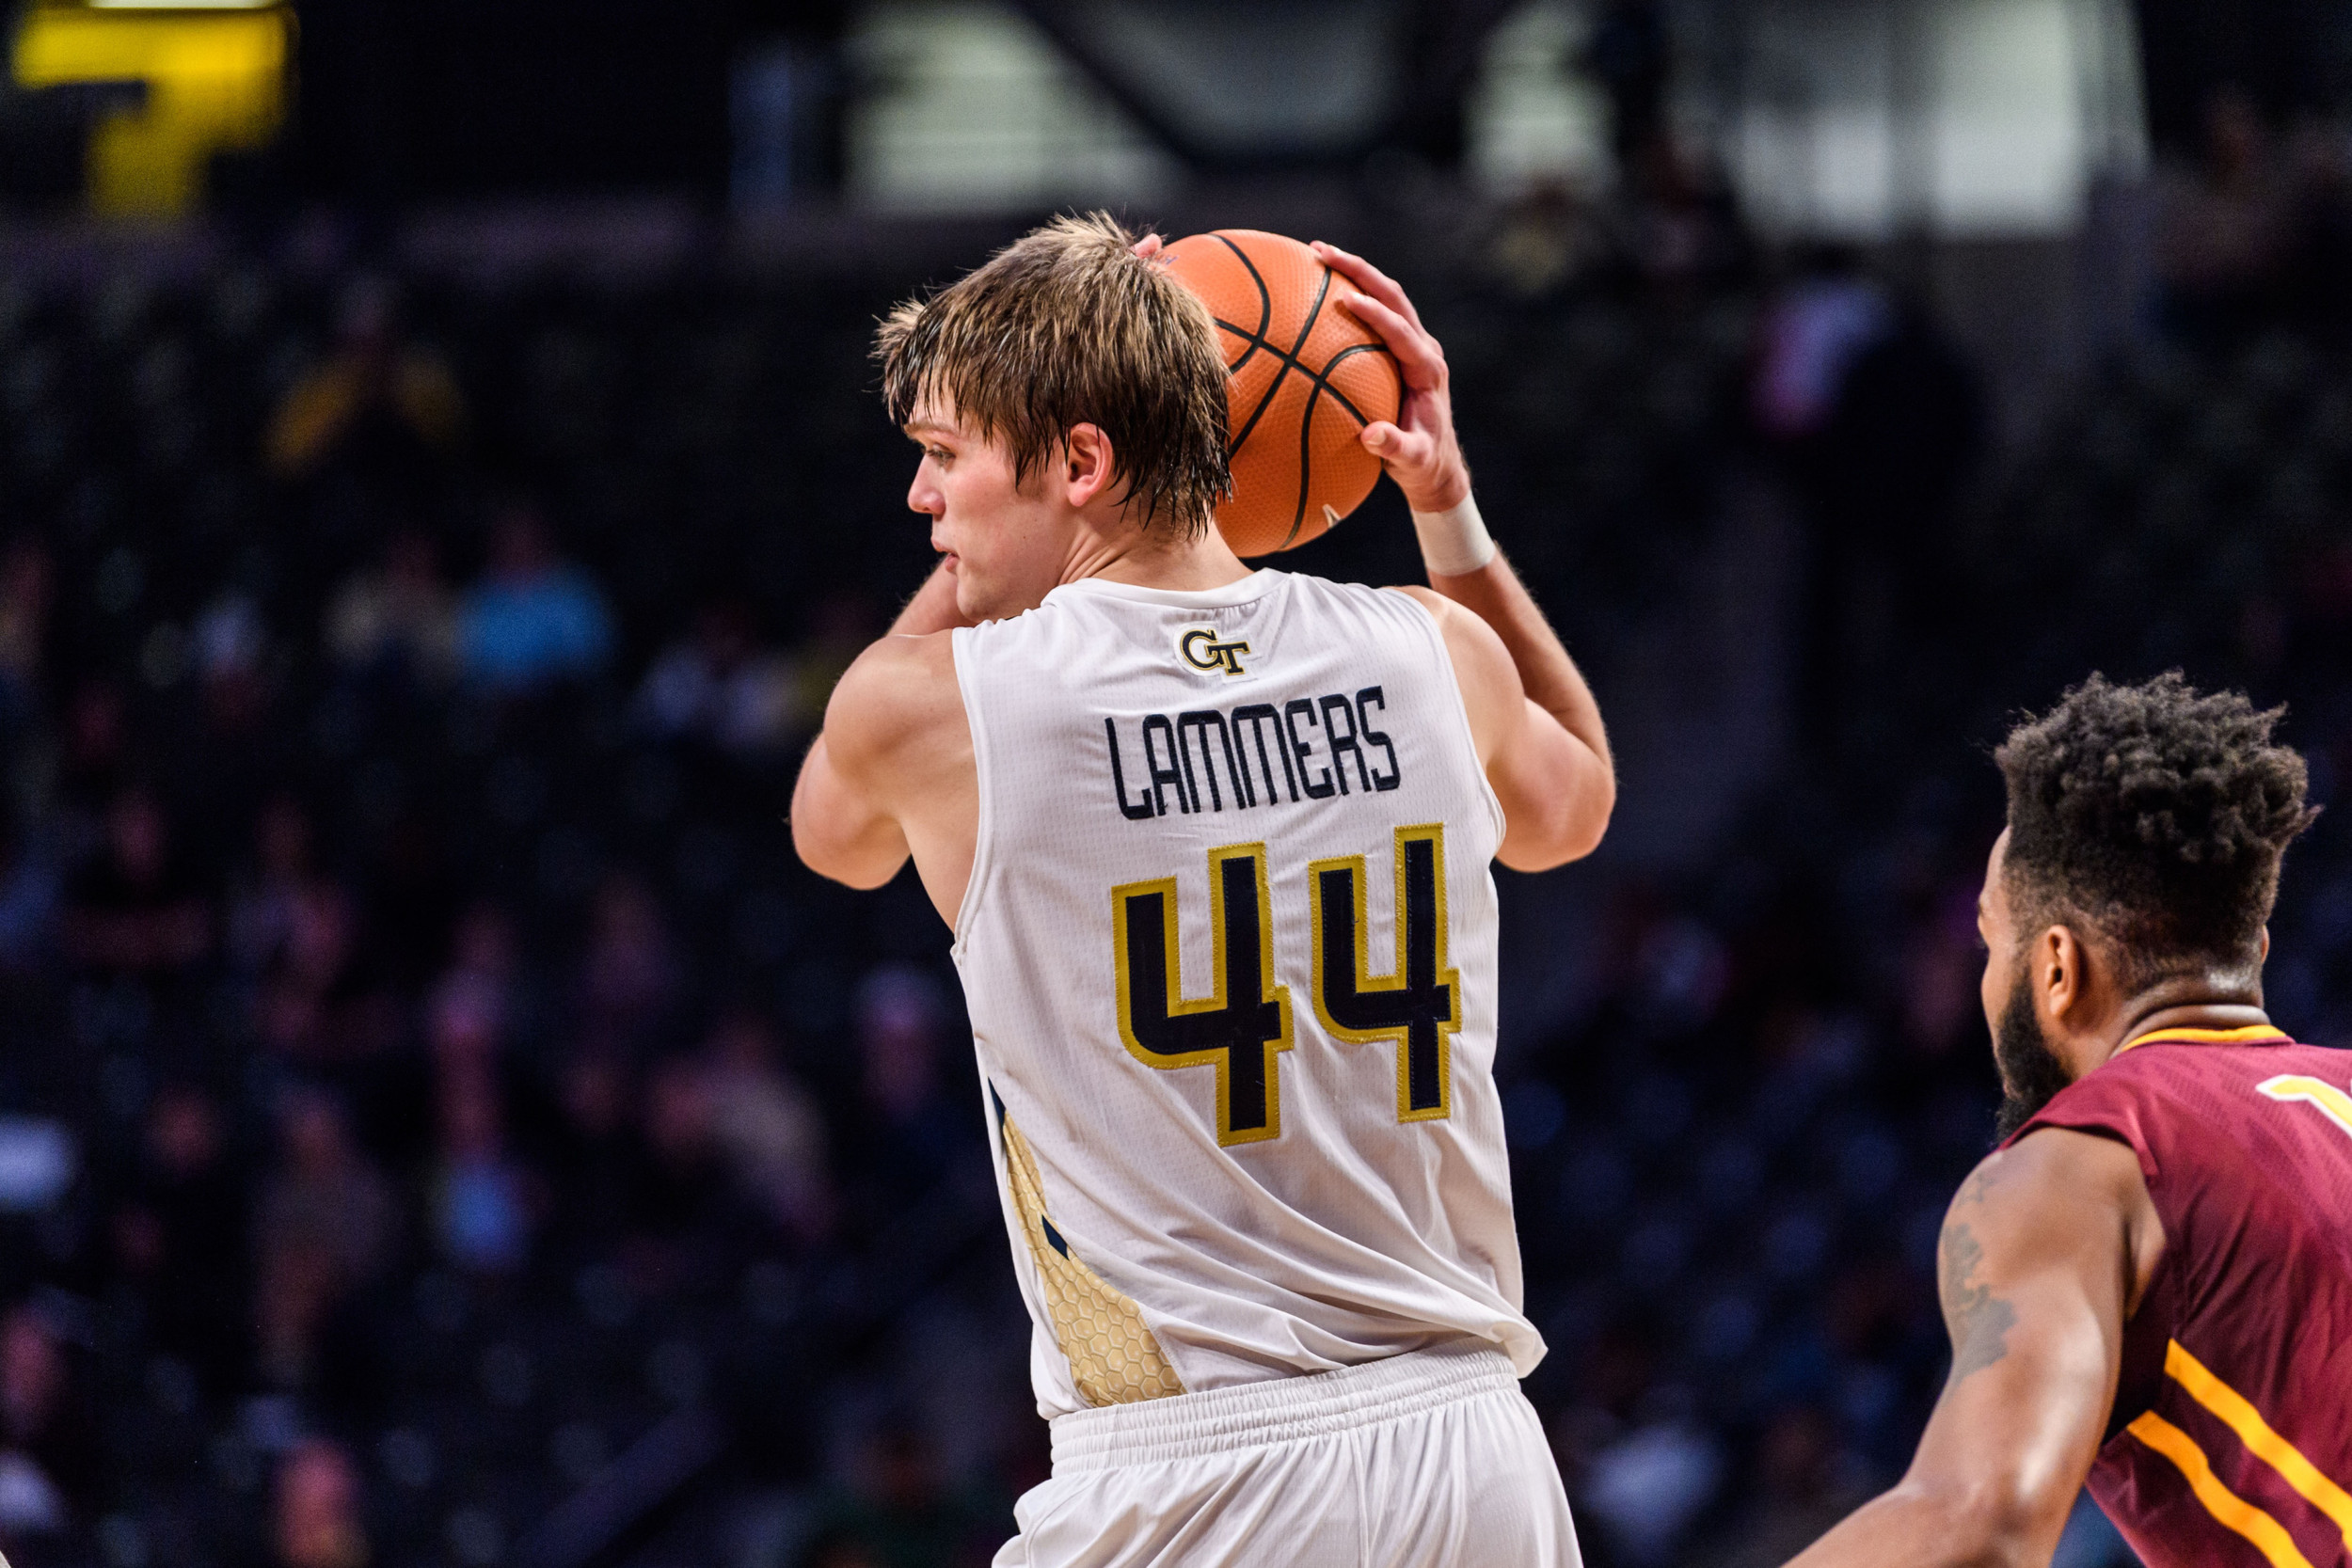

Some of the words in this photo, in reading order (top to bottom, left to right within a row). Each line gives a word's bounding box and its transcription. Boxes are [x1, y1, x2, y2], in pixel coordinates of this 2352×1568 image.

[1179, 628, 1250, 676] GT
[1105, 685, 1401, 820] LAMMERS
[1111, 822, 1462, 1148] 44
